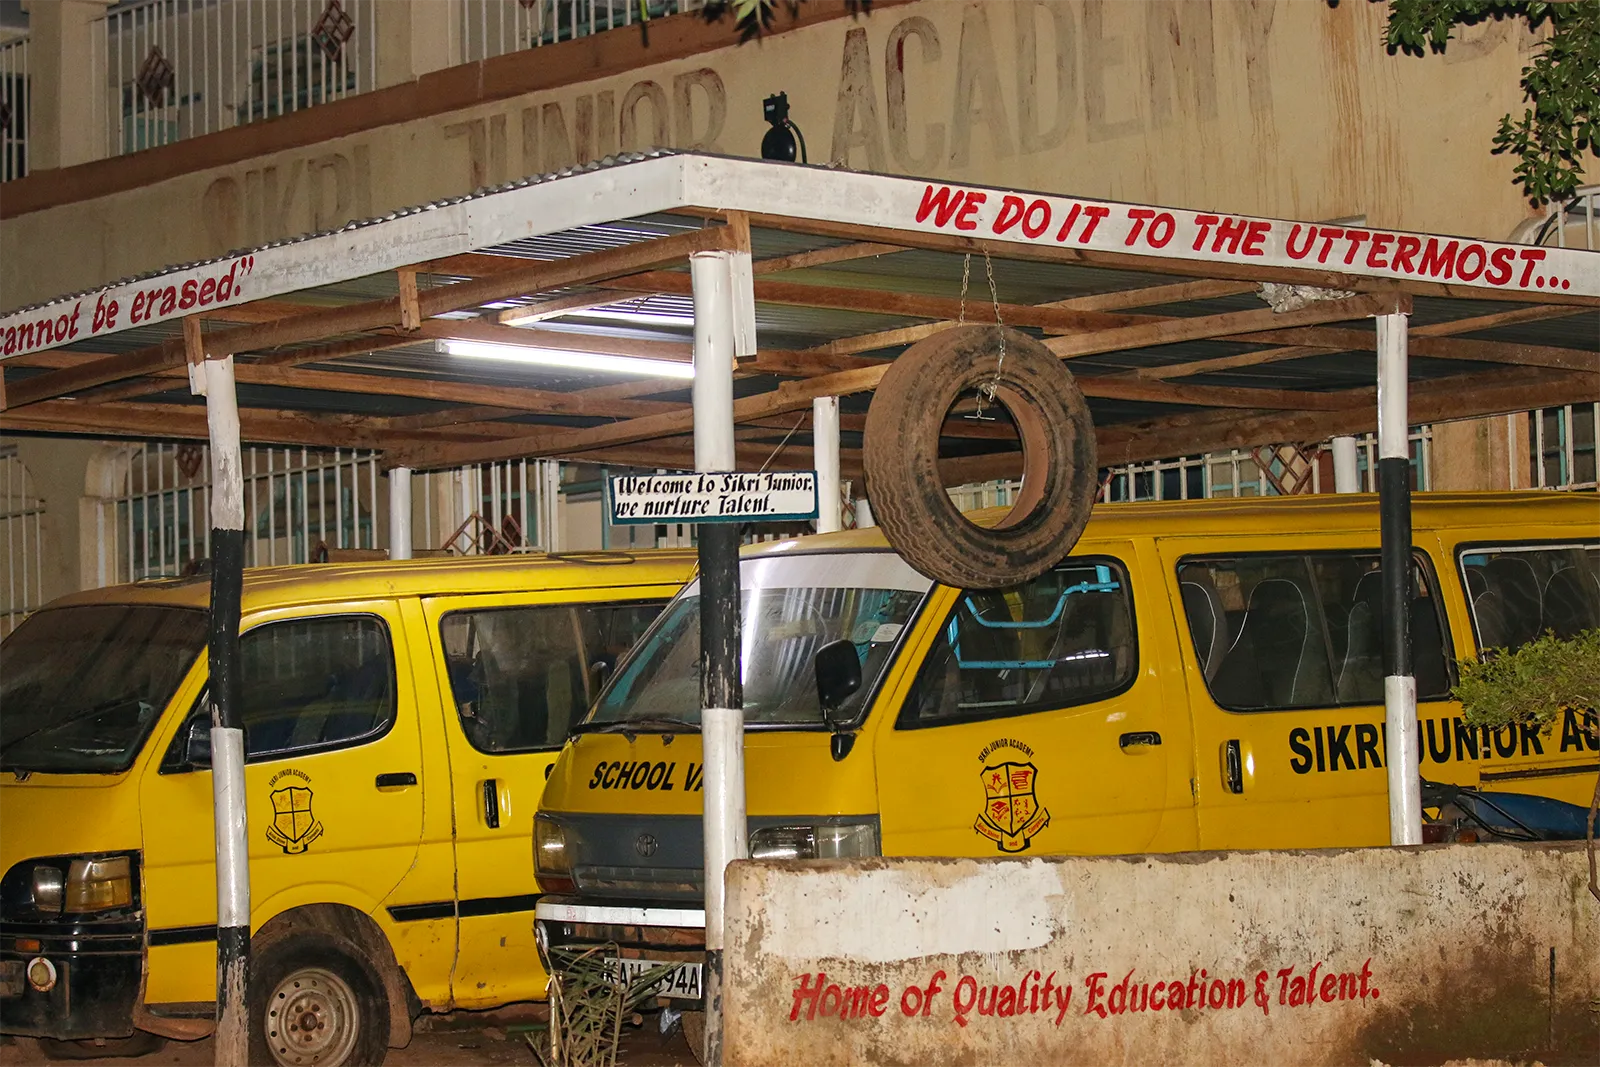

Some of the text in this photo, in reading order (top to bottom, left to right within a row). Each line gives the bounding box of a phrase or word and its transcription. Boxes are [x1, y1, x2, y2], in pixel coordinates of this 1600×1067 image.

[915, 185, 1570, 290] WE DO IT TO THE UTTERMOST...
[92, 293, 119, 333] be
[618, 474, 692, 496] Welcome
[697, 475, 715, 493] to
[720, 474, 760, 493] Sikri
[616, 493, 776, 517] we nurture Talent.
[989, 738, 1008, 752] JUNIOR
[1009, 738, 1035, 758] ACADEMY
[293, 769, 312, 784] ACADEMY
[589, 761, 677, 791] SCHOOL
[790, 958, 1380, 1028] Home of Quality Education & Talent.
